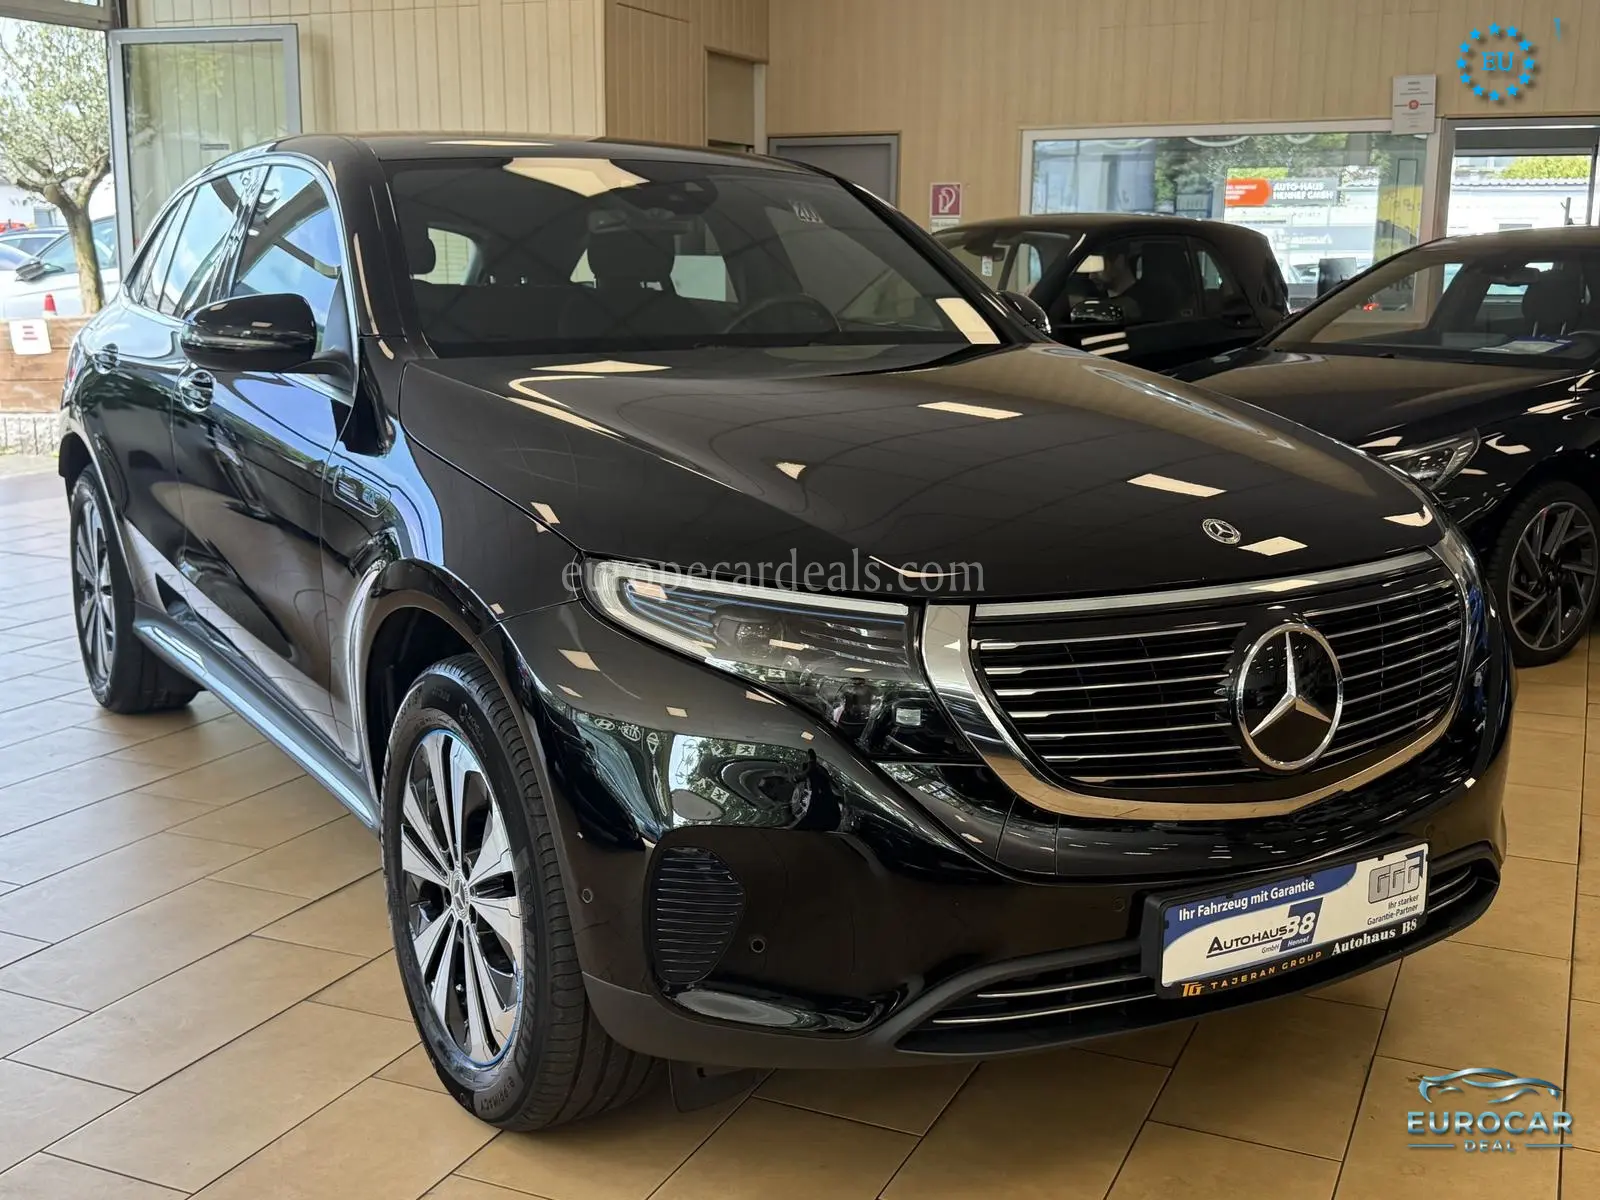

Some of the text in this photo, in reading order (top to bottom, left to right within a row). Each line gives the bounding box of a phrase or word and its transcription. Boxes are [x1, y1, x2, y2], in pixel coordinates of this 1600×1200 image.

[1179, 880, 1315, 921] Ihr Fahrzeug mit Garantie
[1367, 904, 1419, 925] Garantie-Partner
[1397, 894, 1419, 906] starker
[1331, 918, 1418, 956] Autohaus B8
[1211, 966, 1276, 990] TAJERAN
[1281, 951, 1322, 970] GROUP
